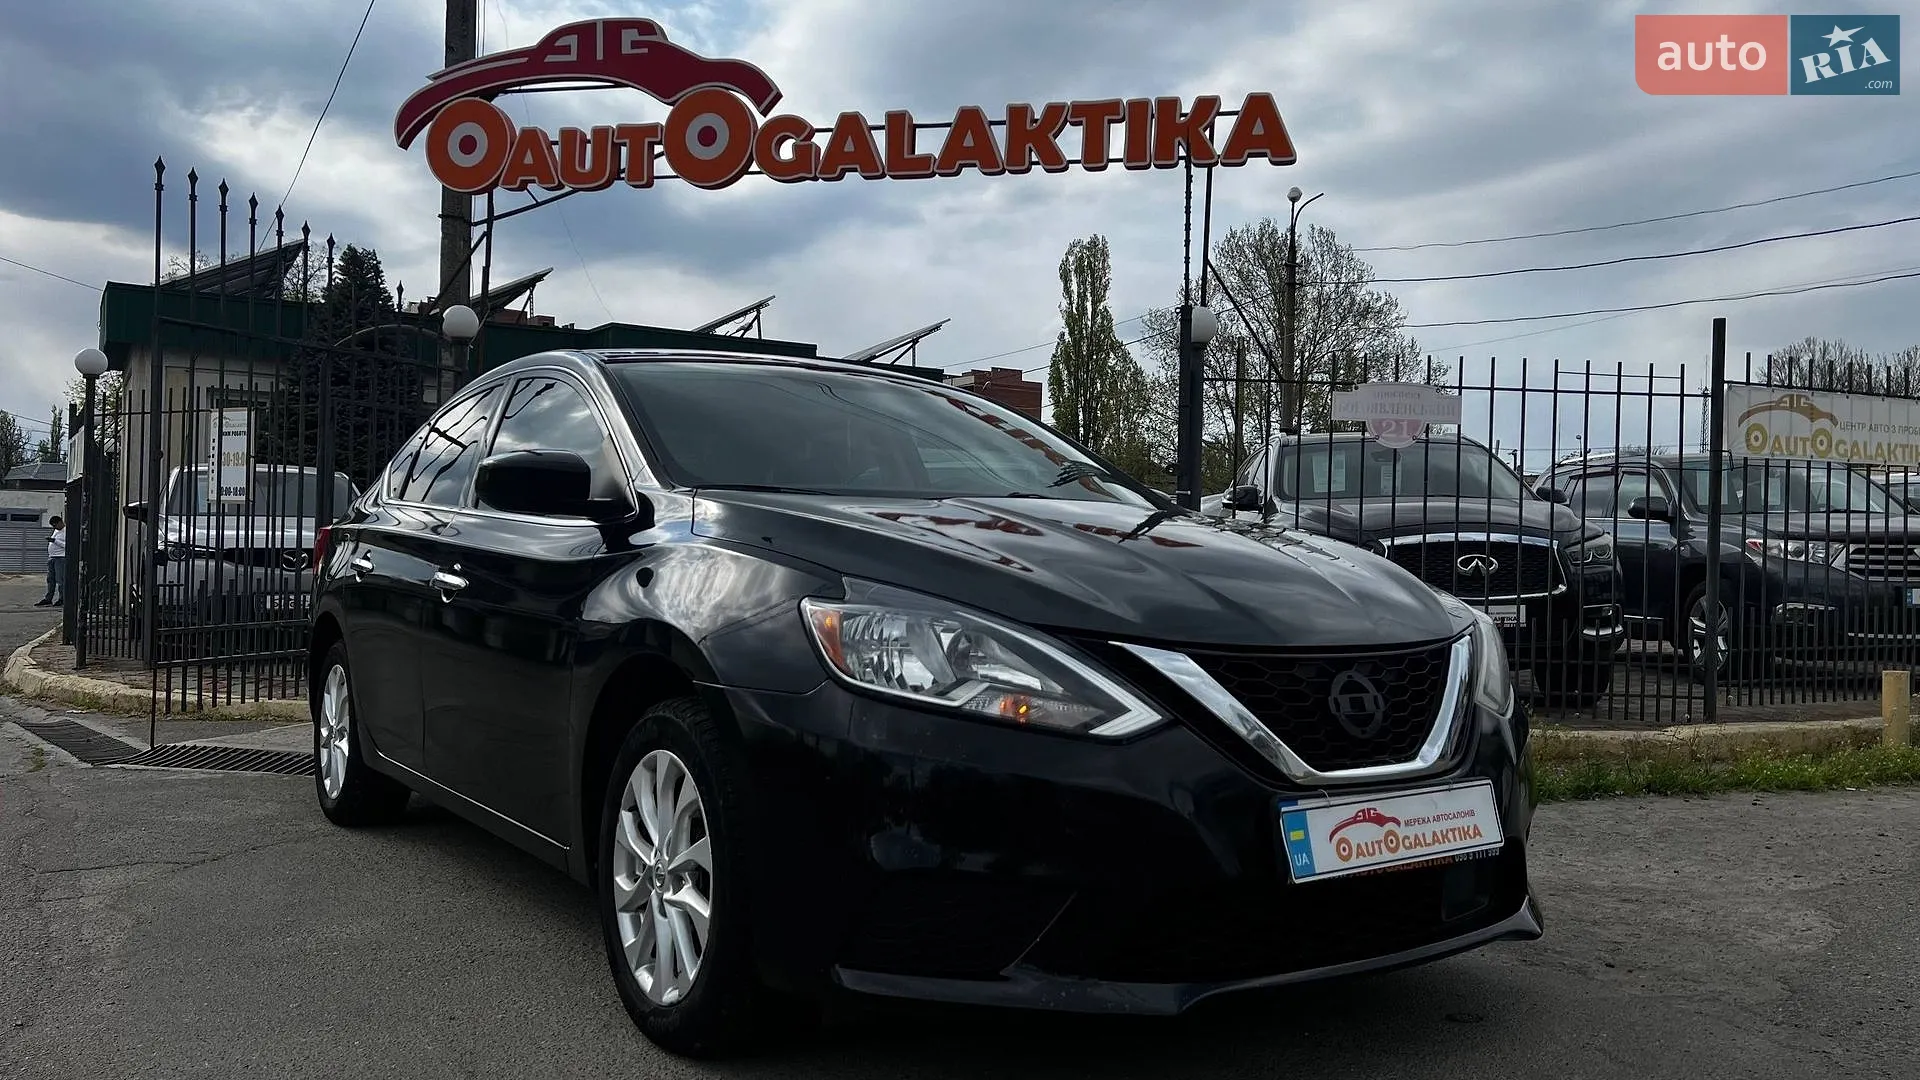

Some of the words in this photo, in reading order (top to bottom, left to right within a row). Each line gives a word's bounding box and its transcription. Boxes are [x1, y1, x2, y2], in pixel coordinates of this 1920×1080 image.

[1382, 420, 1409, 437] 21
[1839, 421, 1867, 432] ЦЕНТР
[1868, 423, 1890, 433] АВТО
[1897, 425, 1920, 436] ПРОБ
[1403, 815, 1431, 828] МЕРЕЖА
[1432, 808, 1476, 824] АВТОСАЛОНІВ
[1293, 852, 1310, 867] UA
